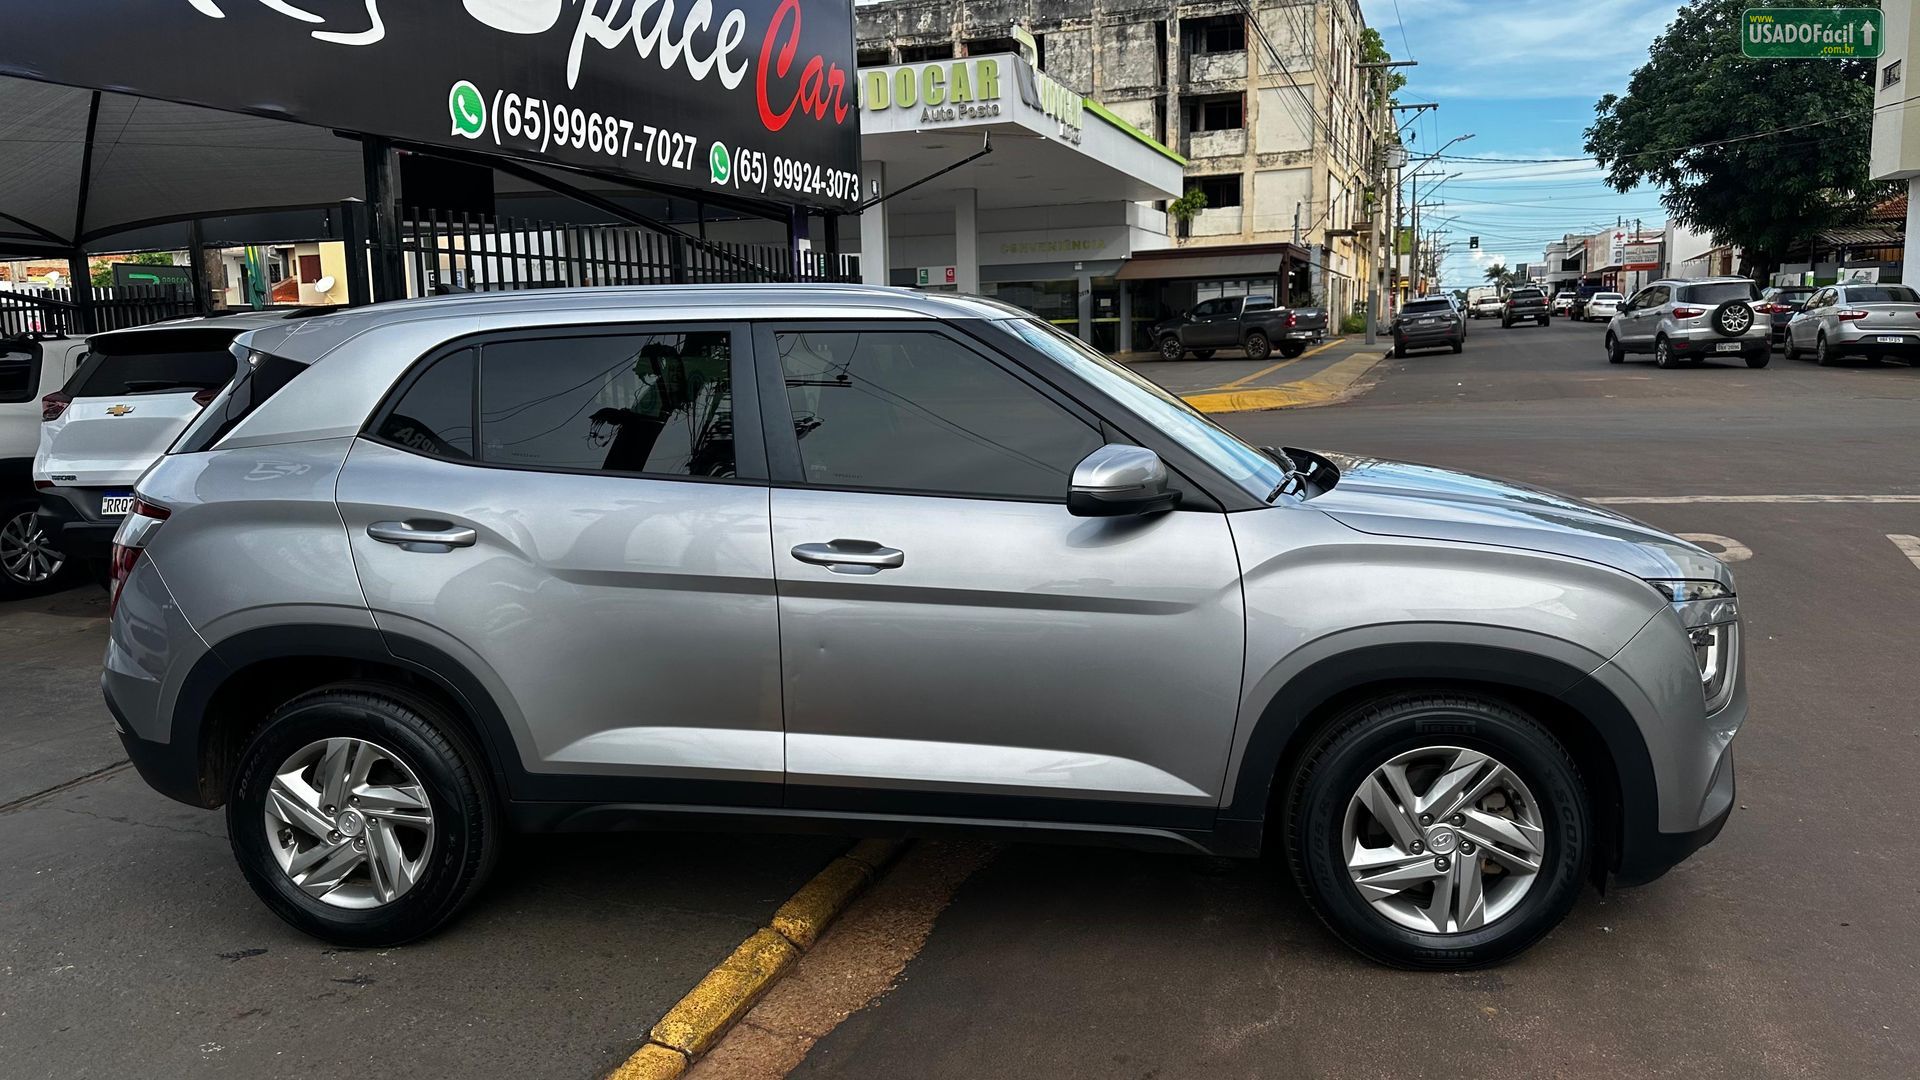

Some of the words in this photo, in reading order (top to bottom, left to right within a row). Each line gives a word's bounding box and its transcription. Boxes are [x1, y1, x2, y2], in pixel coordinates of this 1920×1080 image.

[755, 0, 849, 132] Car
[858, 59, 1001, 111] DOCAR
[491, 89, 698, 171] (65)99687-7027
[920, 106, 956, 123] Auto
[958, 102, 1001, 120] Posto
[732, 147, 768, 194] (65)
[773, 155, 860, 203] 99924-3073
